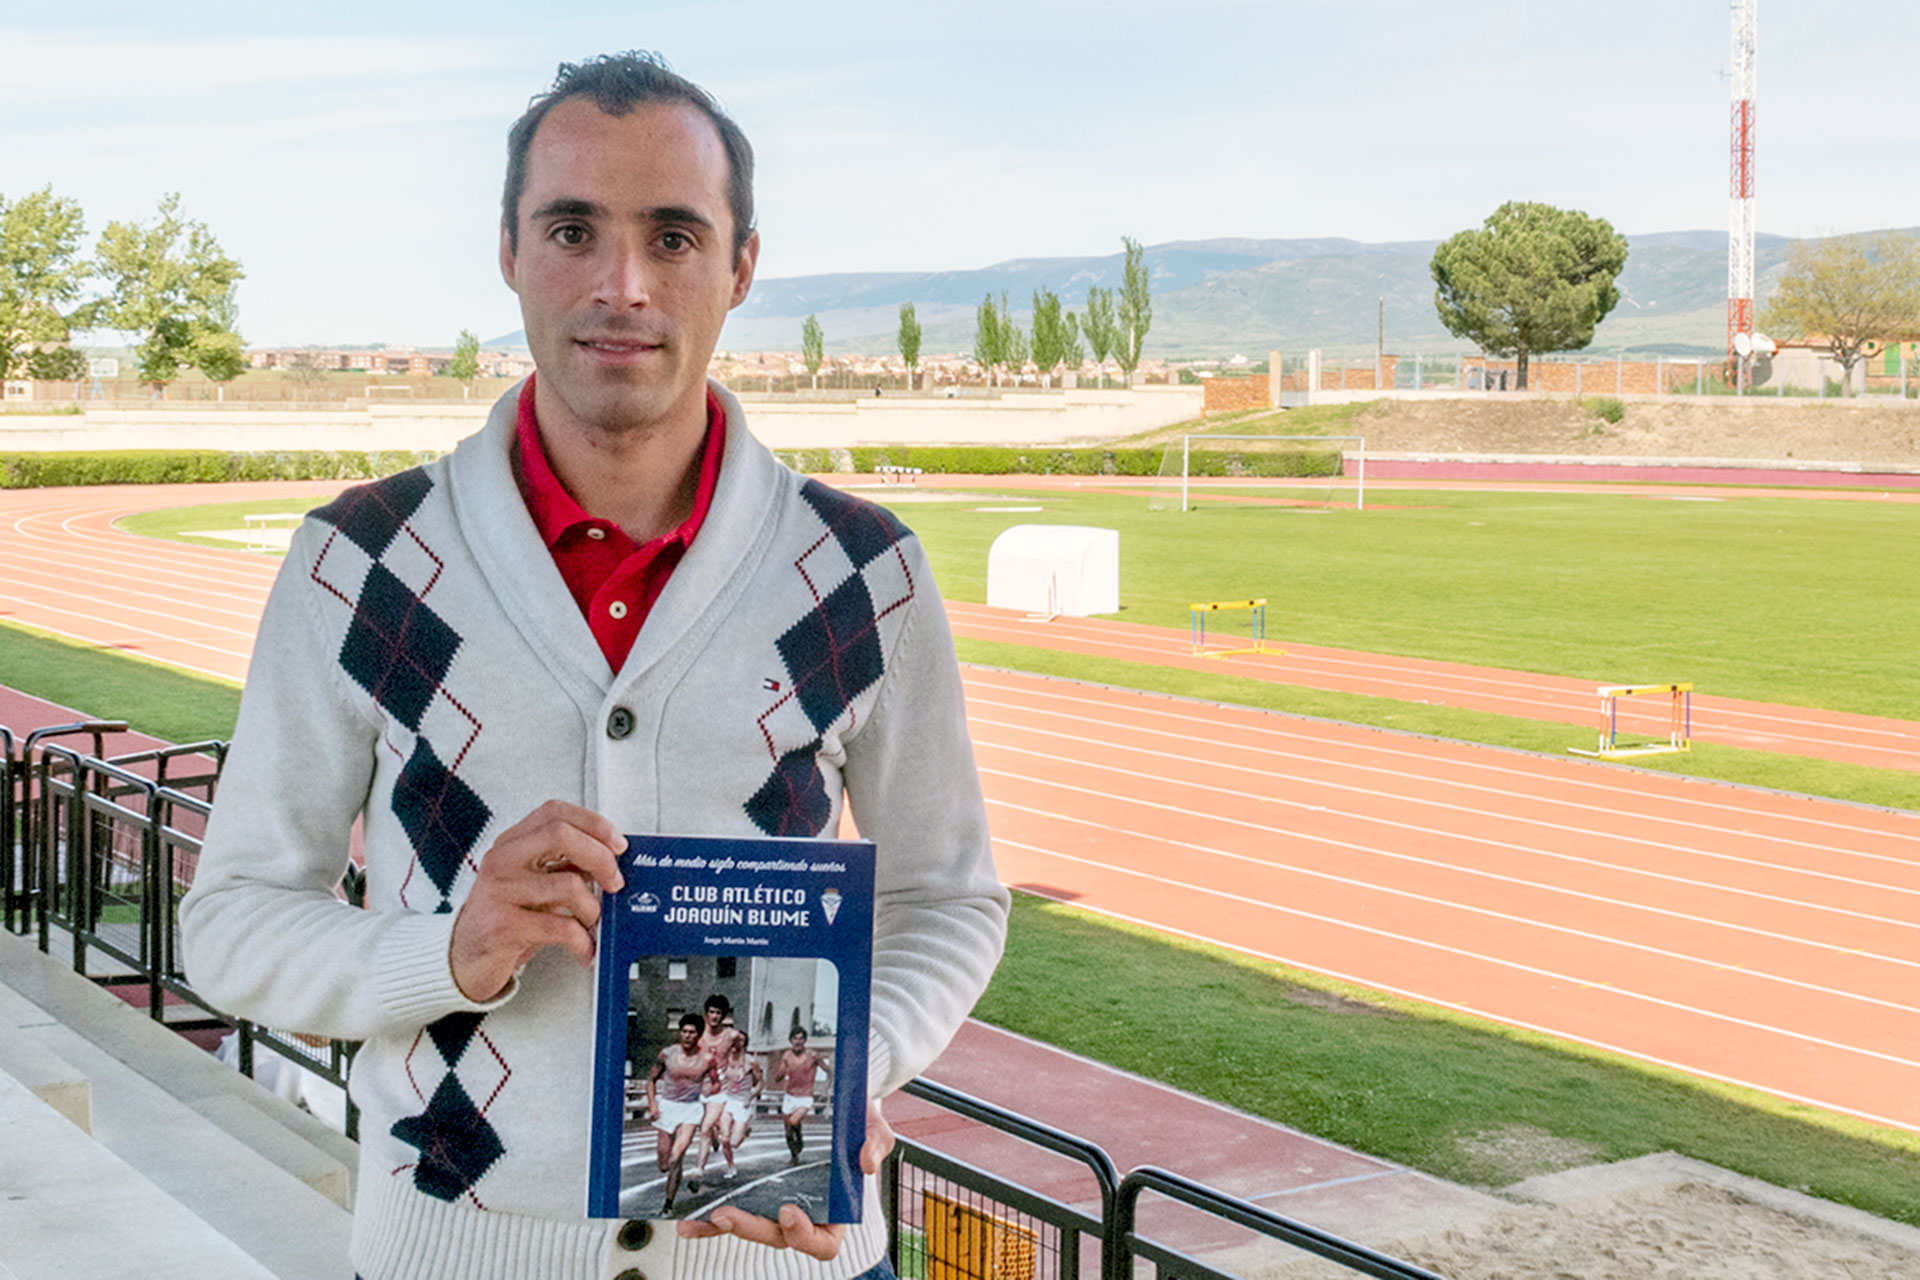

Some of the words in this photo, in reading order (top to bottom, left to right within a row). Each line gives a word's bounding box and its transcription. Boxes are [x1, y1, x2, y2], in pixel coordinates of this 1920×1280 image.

[659, 854, 673, 868] de
[675, 856, 706, 869] medio
[708, 856, 735, 875] siglo
[736, 858, 808, 873] compartiendo
[672, 885, 718, 903] CLUB
[722, 884, 806, 905] ATLÉTICO
[664, 904, 744, 925] JOAQUÍN
[748, 909, 810, 927] BLUME
